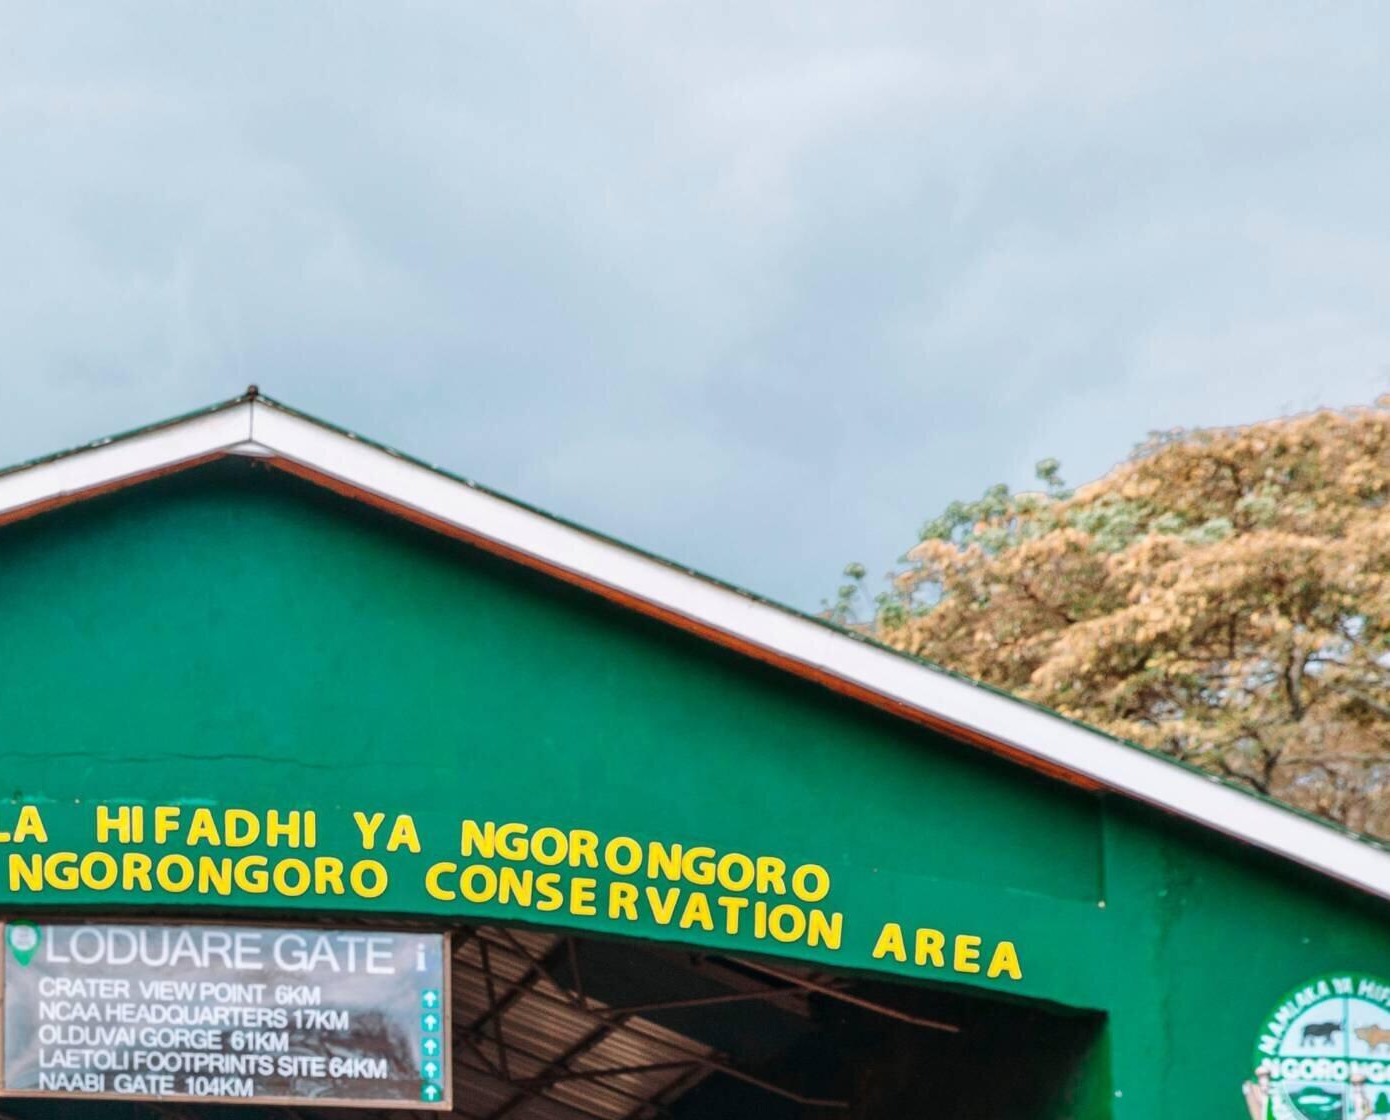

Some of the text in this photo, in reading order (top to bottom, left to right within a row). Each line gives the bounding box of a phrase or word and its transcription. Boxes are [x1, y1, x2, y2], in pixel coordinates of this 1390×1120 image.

[96, 806, 316, 848] HIFADHI
[353, 812, 421, 853] YA
[461, 820, 830, 902] NGORONGORO
[9, 852, 388, 898] NGORONGORO
[425, 862, 843, 950] CONSERVATION
[872, 922, 1023, 979] AREA
[45, 926, 264, 971] LODUARE
[273, 933, 396, 975] GATE
[38, 976, 321, 1006] CRATER VIEW POINT 6KM
[38, 1001, 350, 1031] NCAA HEADQUARTERS 17KM
[38, 1024, 290, 1052] OLDUVAI GORGE 61KM
[38, 1048, 388, 1079] LAETOLI FOOTPRINTS SITE 64KM
[38, 1072, 255, 1098] NAABI GATE 104KM
